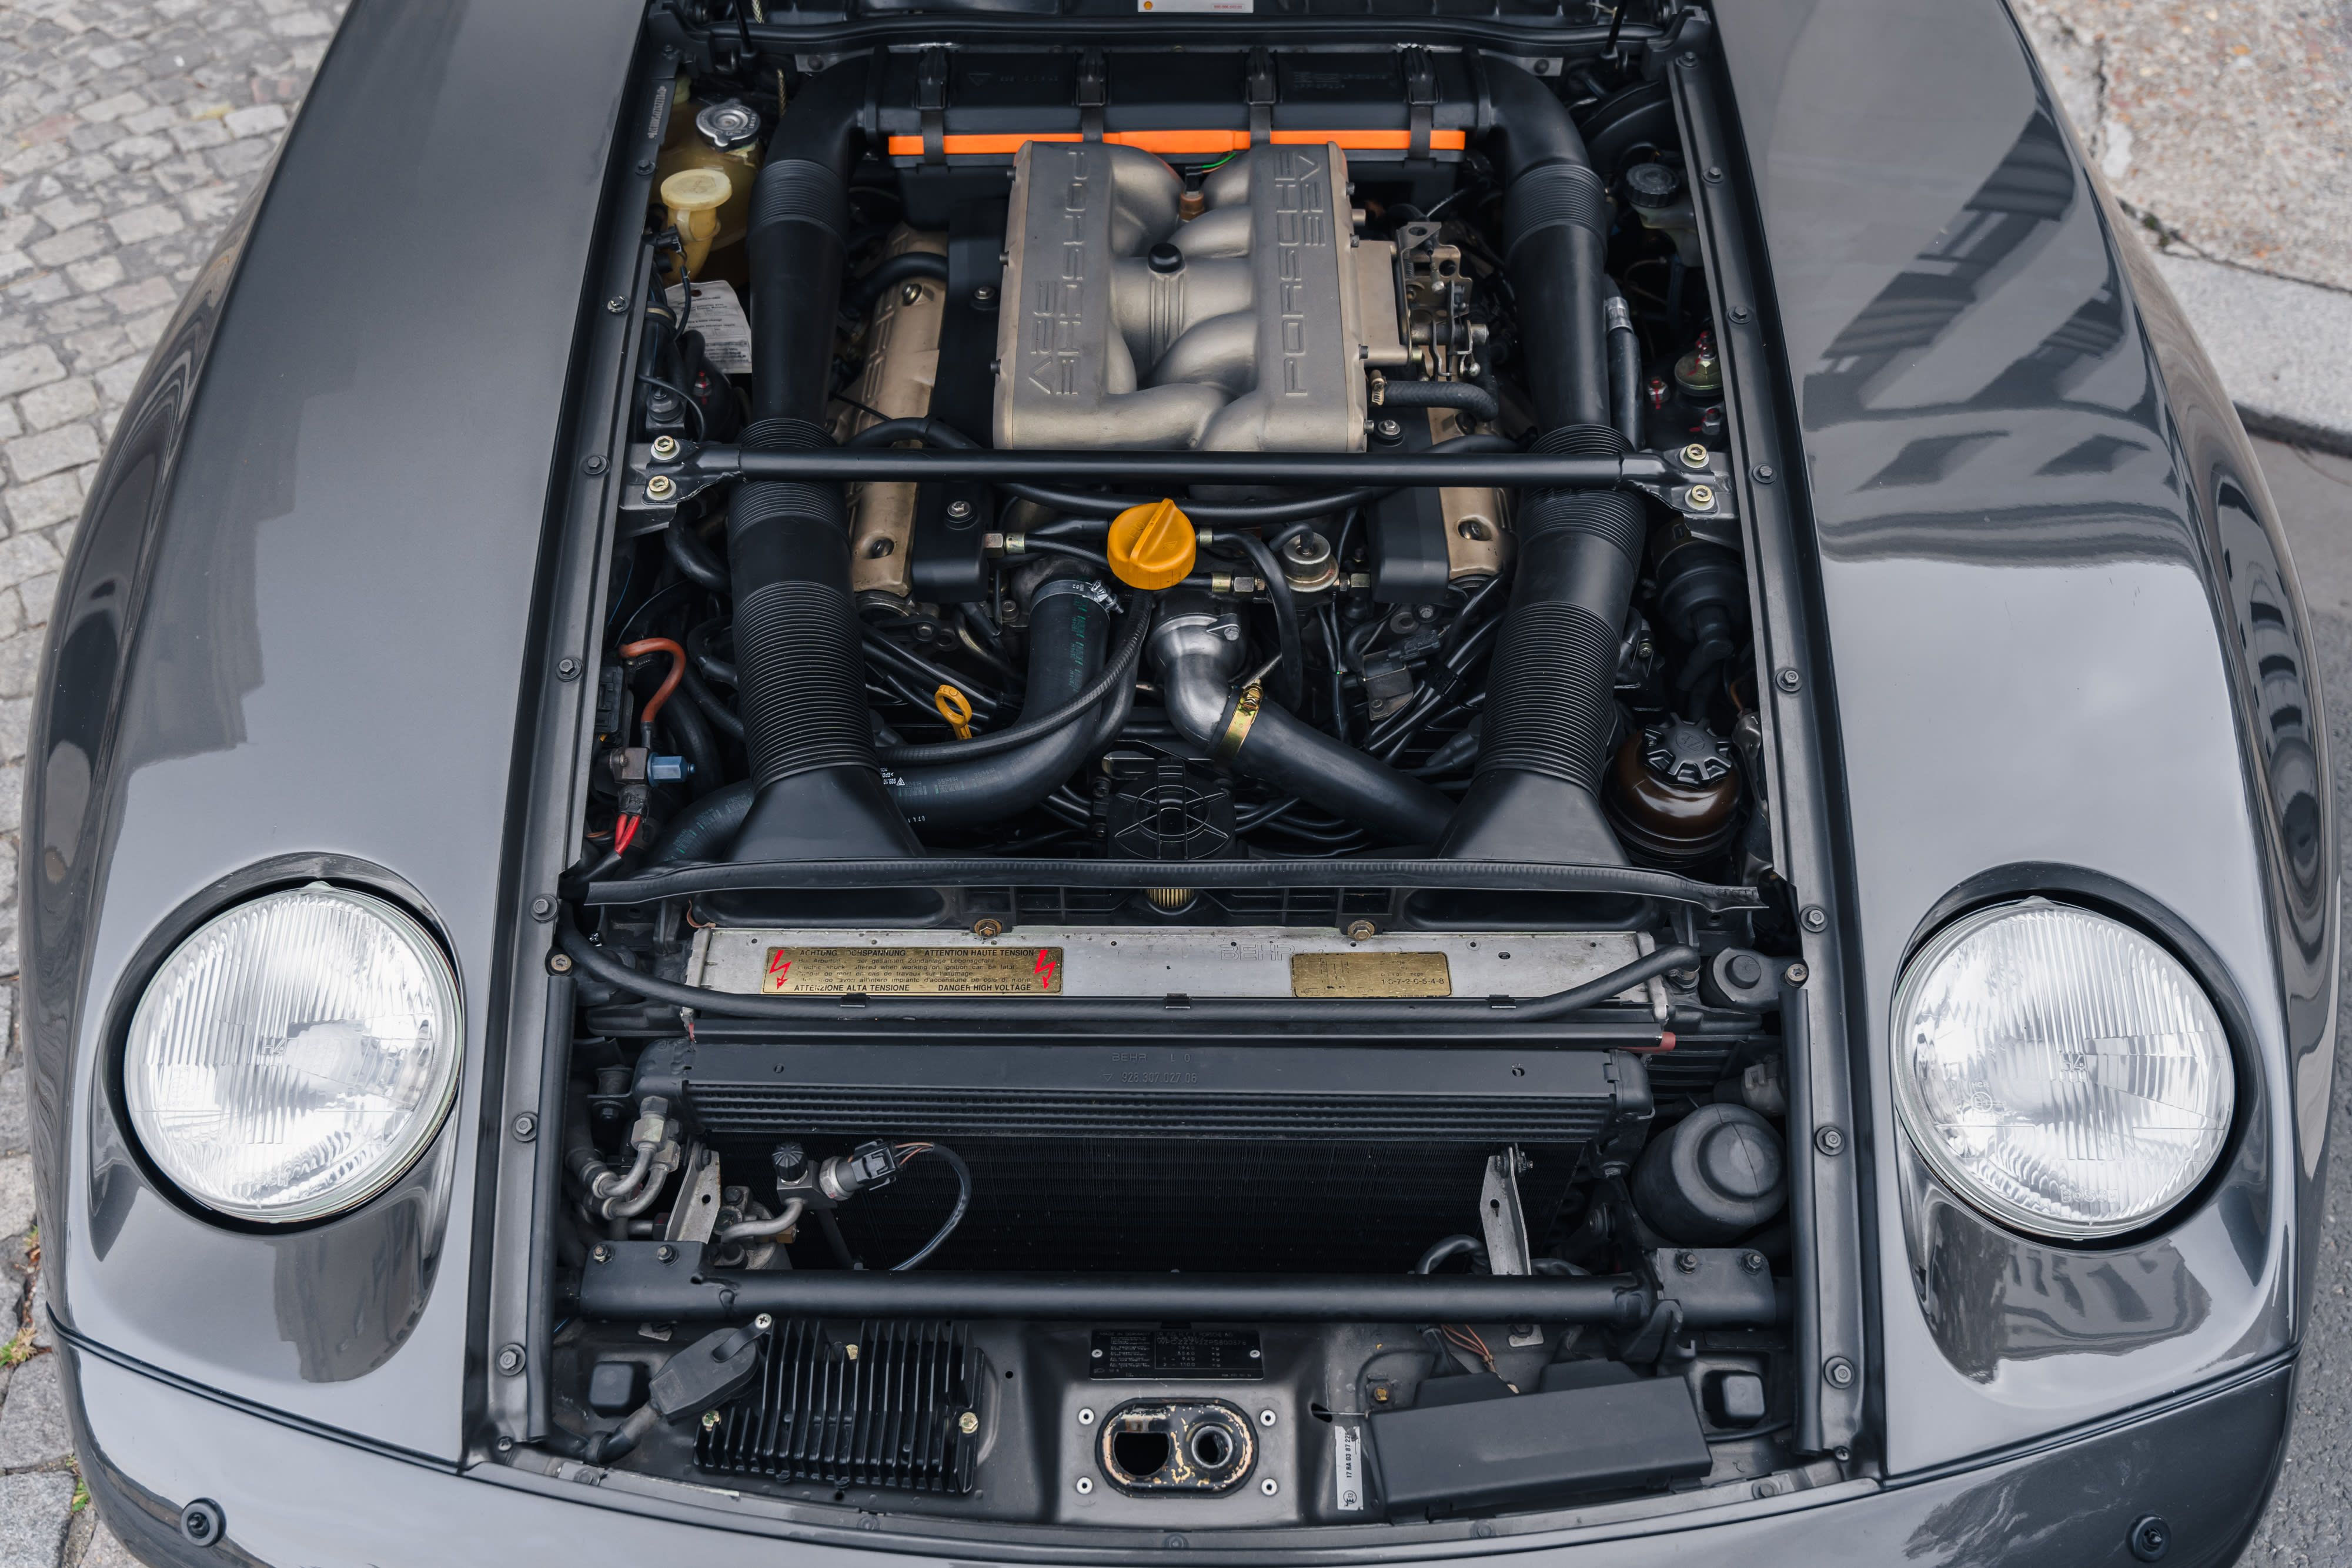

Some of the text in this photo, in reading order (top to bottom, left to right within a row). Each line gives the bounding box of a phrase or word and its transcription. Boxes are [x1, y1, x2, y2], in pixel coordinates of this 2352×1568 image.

[1056, 150, 1089, 396] PORSCHE
[1274, 151, 1308, 397] PORSCHE
[1219, 943, 1295, 961] BEHR
[261, 1036, 286, 1057] H4
[1111, 1053, 1147, 1062] BEHR
[2060, 1052, 2086, 1071] H4
[2060, 1189, 2119, 1203] BOSCH
